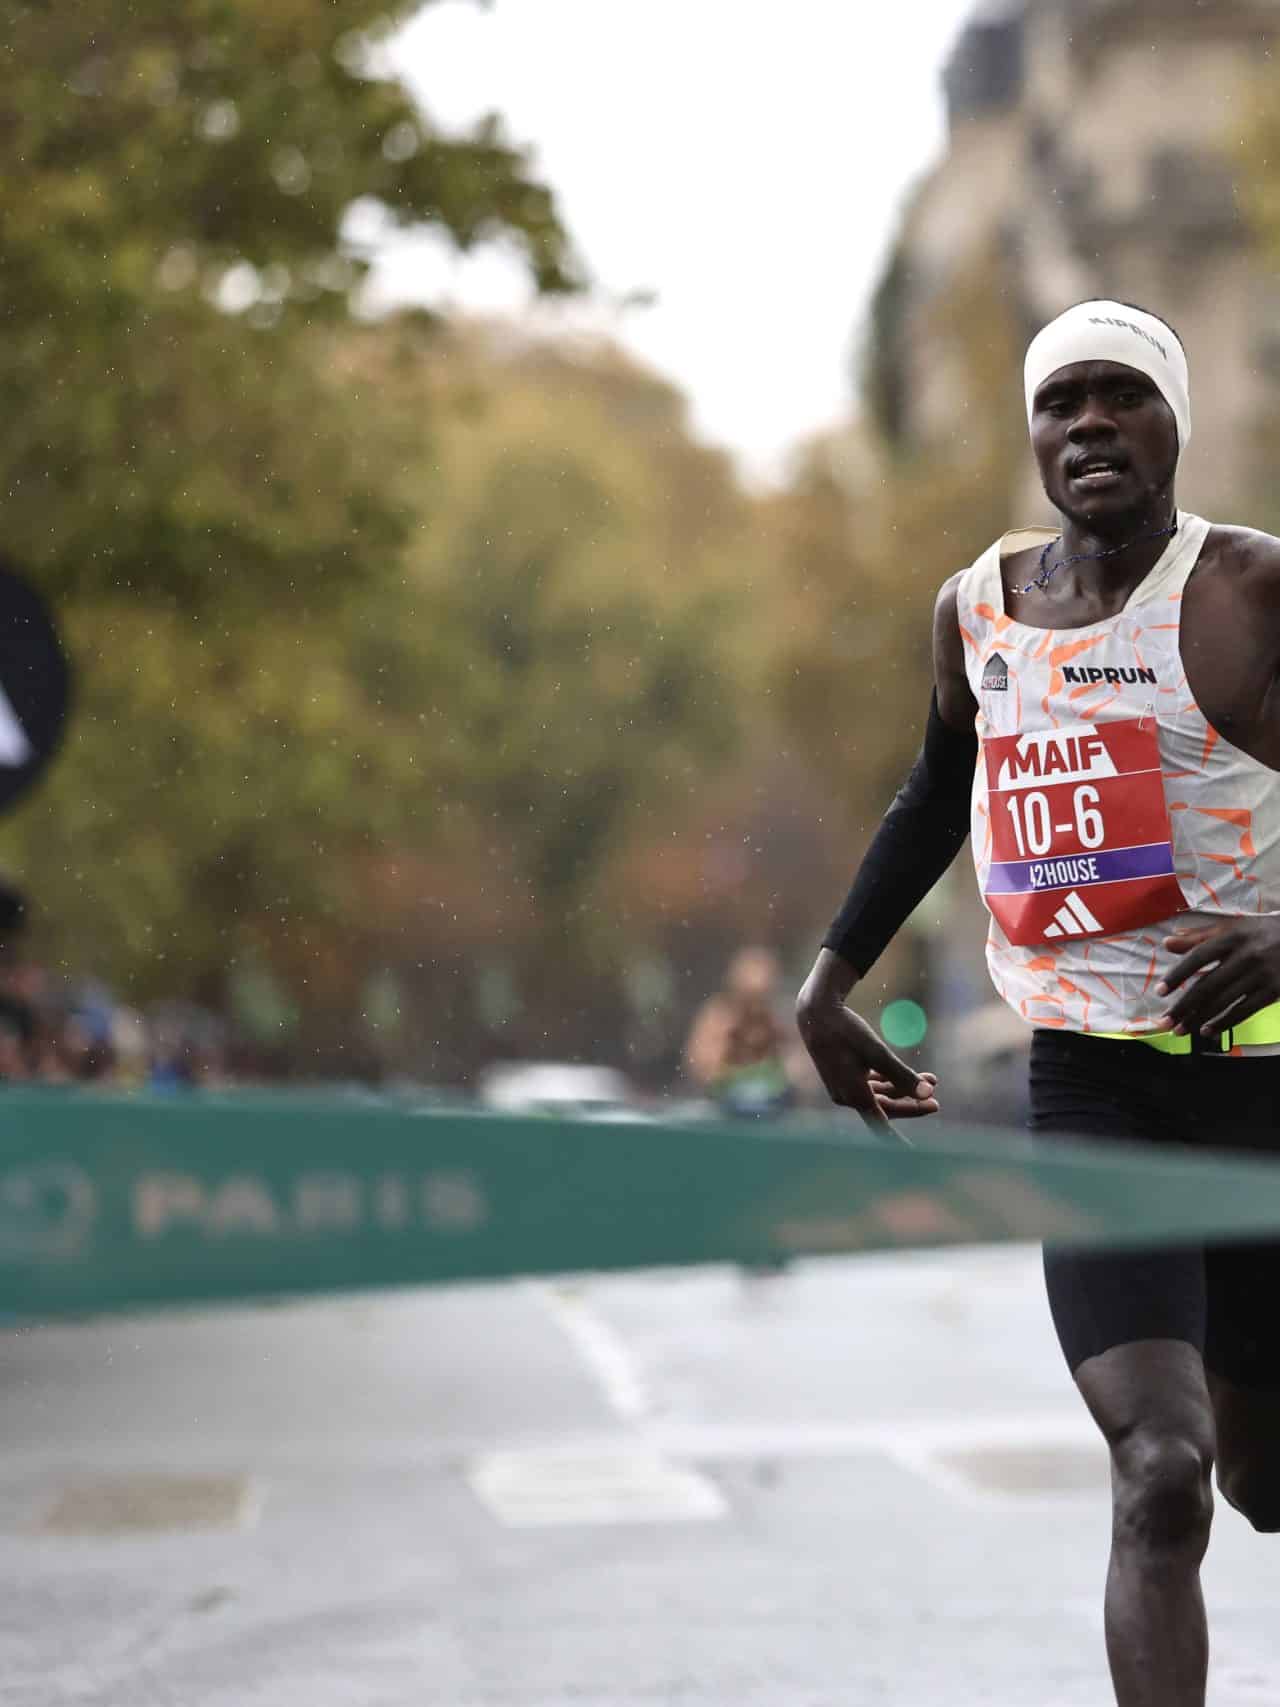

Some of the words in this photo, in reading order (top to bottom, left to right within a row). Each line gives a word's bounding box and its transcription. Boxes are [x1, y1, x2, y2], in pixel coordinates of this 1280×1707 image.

[1062, 666, 1157, 684] KIPRUN
[1007, 734, 1104, 780] MAIF
[1007, 785, 1104, 856] 10-6
[133, 1170, 487, 1240] PARIS
